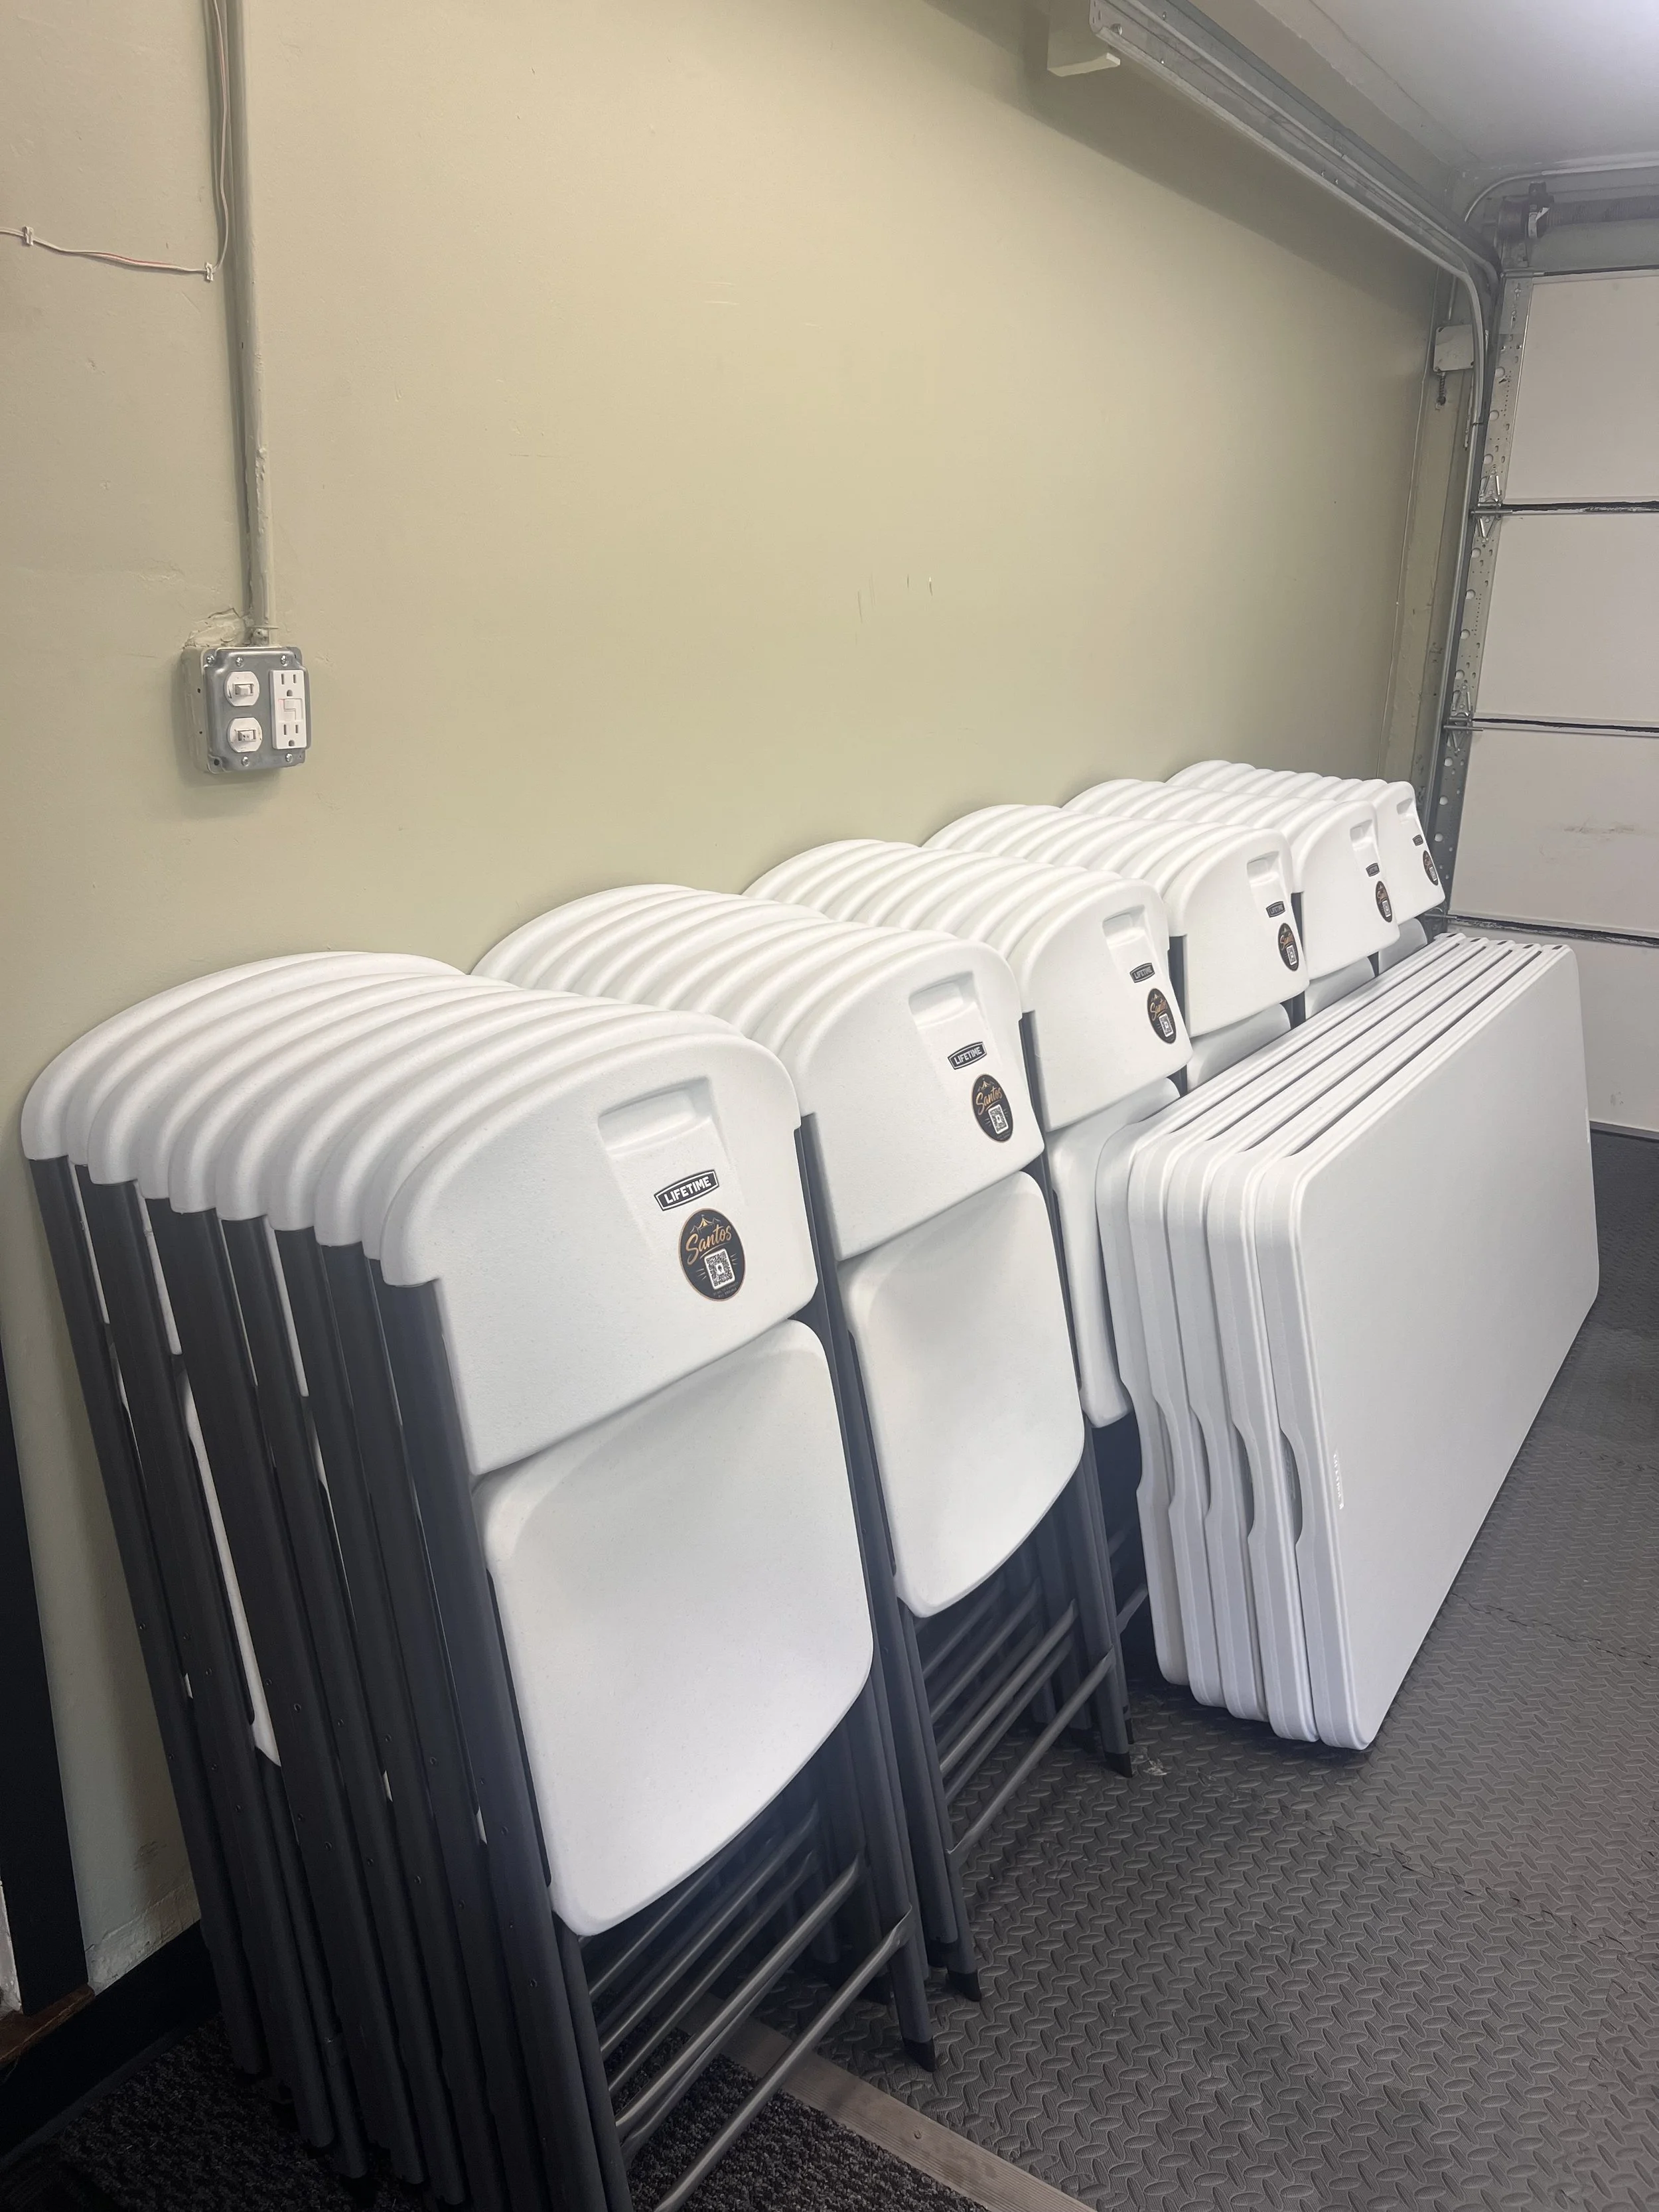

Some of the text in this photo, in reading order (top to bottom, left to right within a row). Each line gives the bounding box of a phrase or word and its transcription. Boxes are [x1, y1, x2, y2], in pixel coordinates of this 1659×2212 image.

[954, 1046, 983, 1065] LIFETIME
[975, 1086, 1003, 1116] Santos
[664, 1176, 711, 1204] LIFETIME
[685, 1224, 732, 1265] Santos
